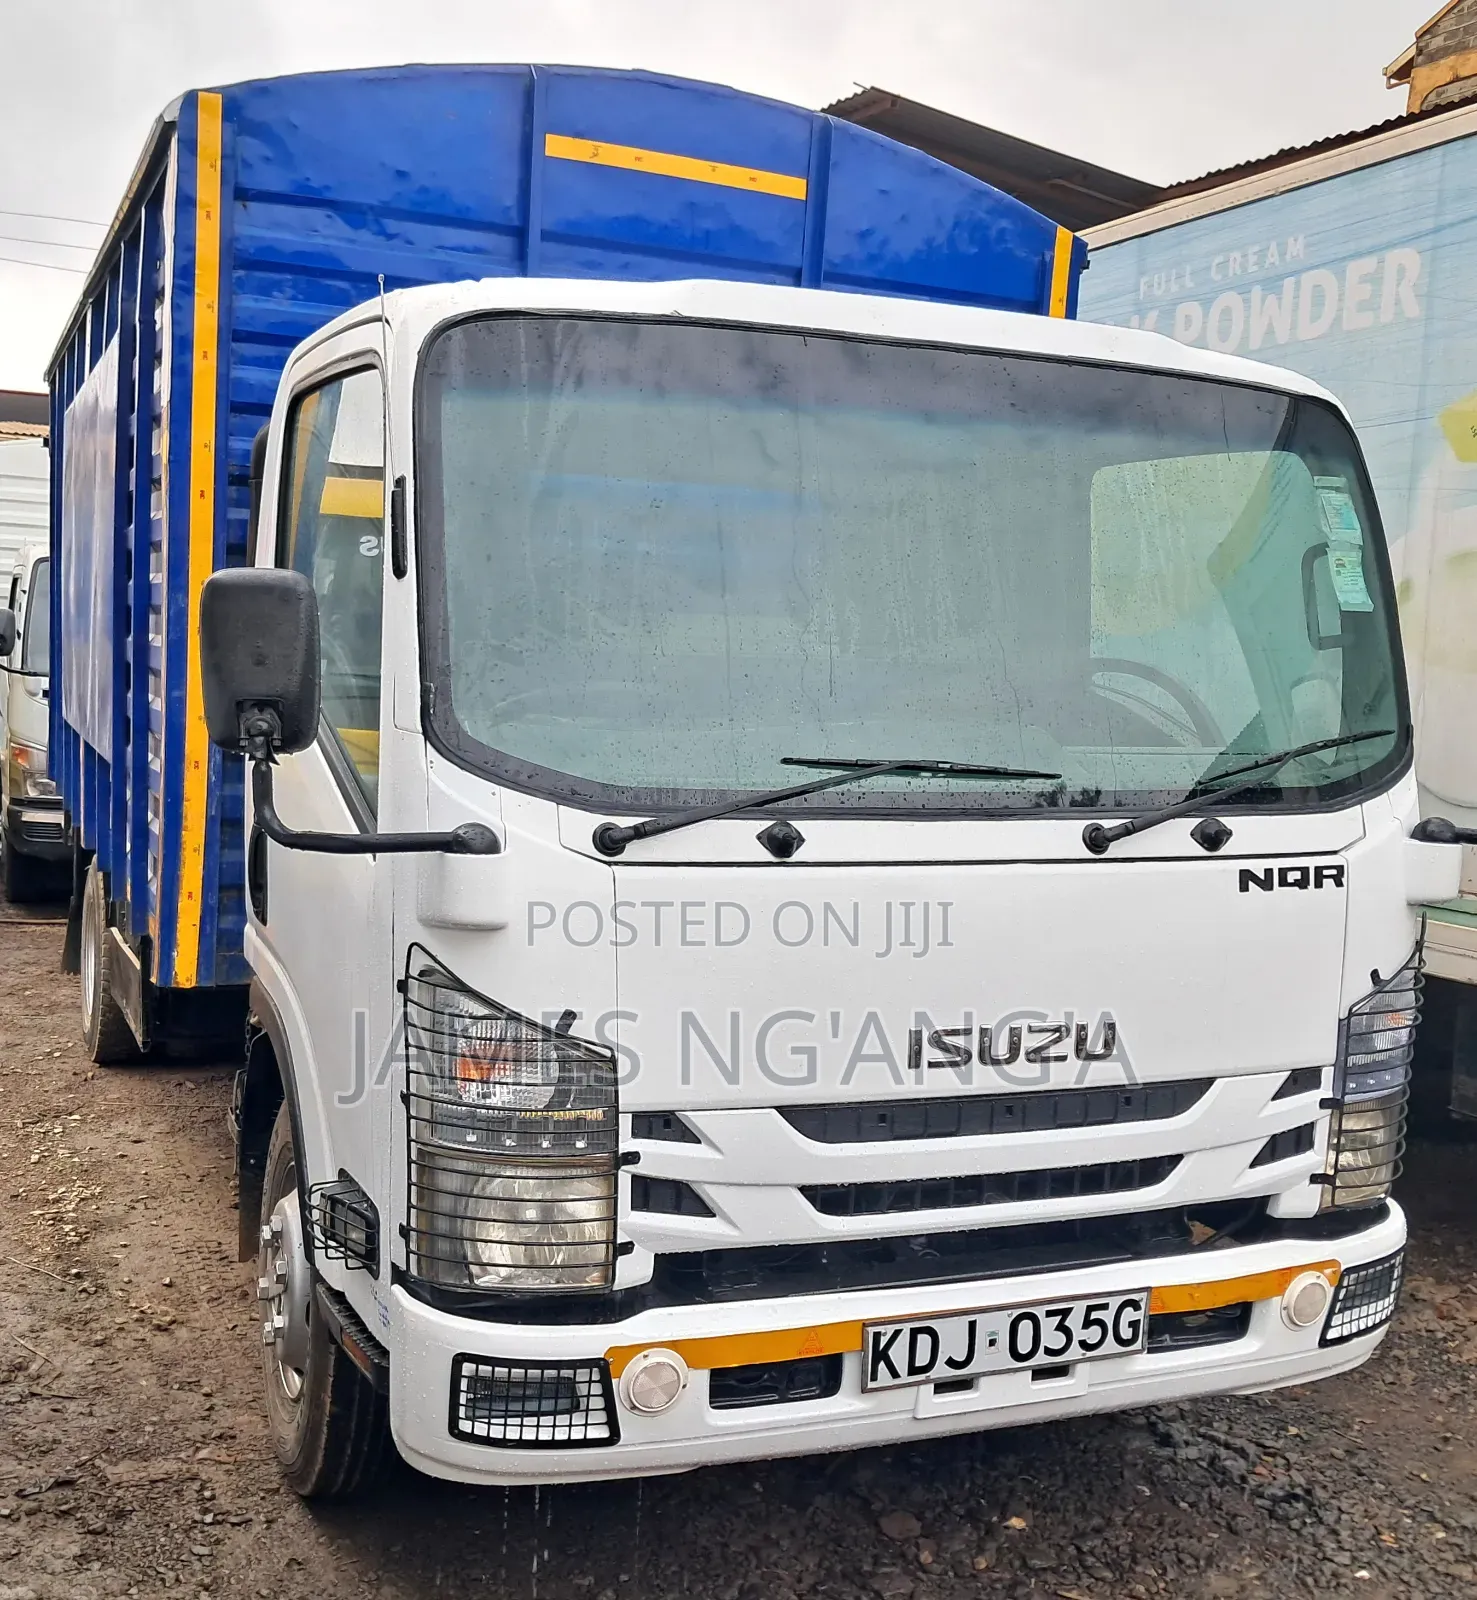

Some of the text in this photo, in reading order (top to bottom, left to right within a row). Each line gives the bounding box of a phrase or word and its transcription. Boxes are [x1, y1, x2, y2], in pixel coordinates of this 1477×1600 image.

[1139, 235, 1306, 300] FULL CREAM
[1172, 247, 1422, 355] POWDER
[1239, 864, 1345, 893] NQR
[907, 1018, 1117, 1071] ISUZU
[869, 1298, 1143, 1382] KDJ 035G
